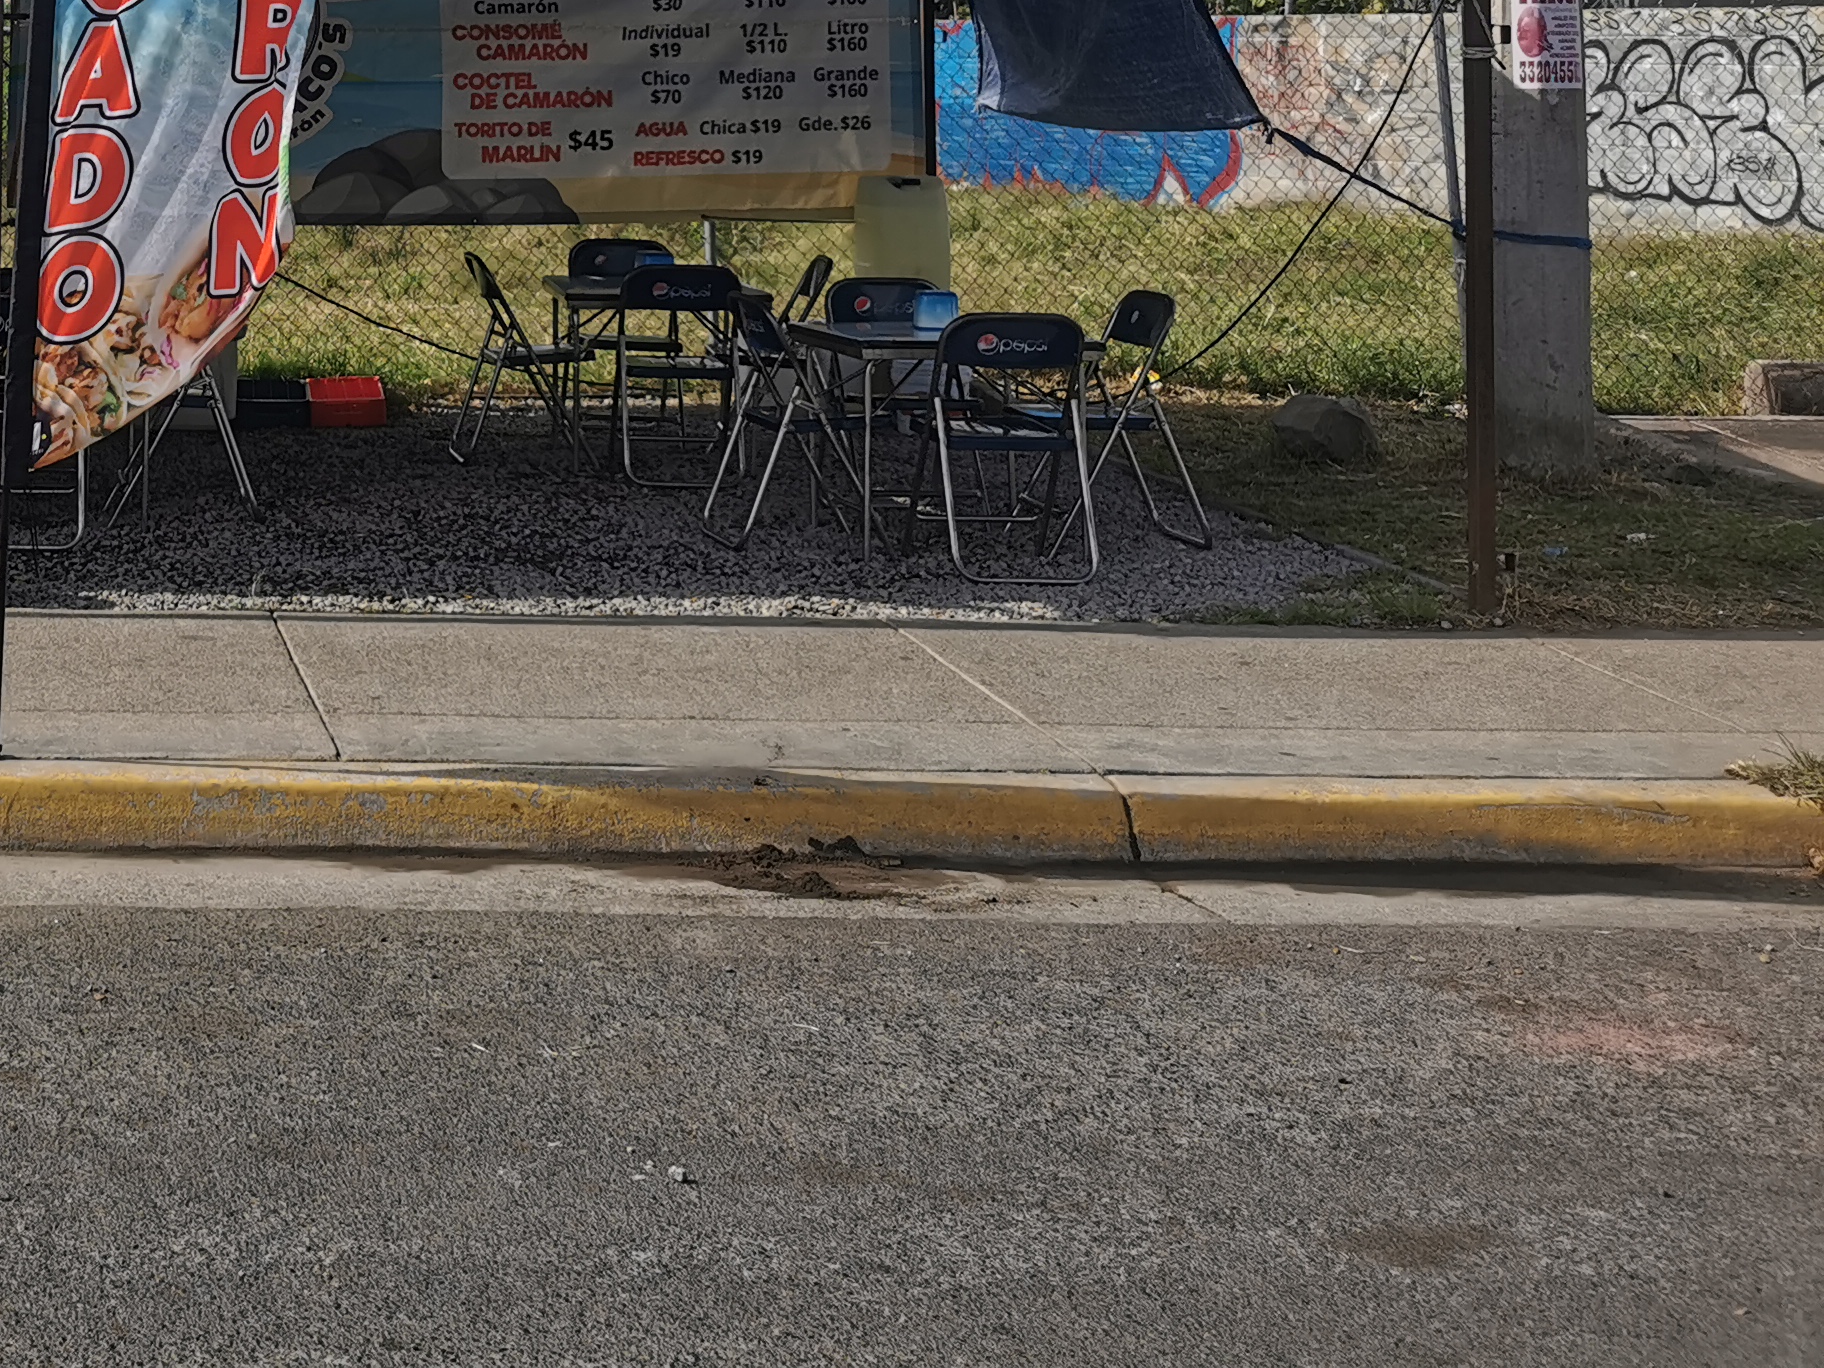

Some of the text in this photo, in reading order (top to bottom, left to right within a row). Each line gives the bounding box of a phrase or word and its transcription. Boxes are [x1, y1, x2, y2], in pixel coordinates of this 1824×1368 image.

[451, 19, 563, 41] CONSOMÉ
[622, 23, 710, 41] Individual
[827, 20, 869, 35] Litro
[476, 36, 868, 62] CAMARÓN $19 $110 $160
[452, 65, 880, 91] COCTEL Chico Mediana Grande
[470, 82, 868, 110] DE CAMARÓN $70 $120 $160
[454, 121, 553, 138] TORITO DE
[635, 120, 688, 137] AGUA
[699, 119, 747, 136] Chica
[750, 118, 782, 135] $19
[481, 129, 614, 164] MARLÍN $45
[633, 149, 763, 167] REFRESCO $19
[670, 283, 711, 300] pepsi
[999, 337, 1048, 354] pepsi
